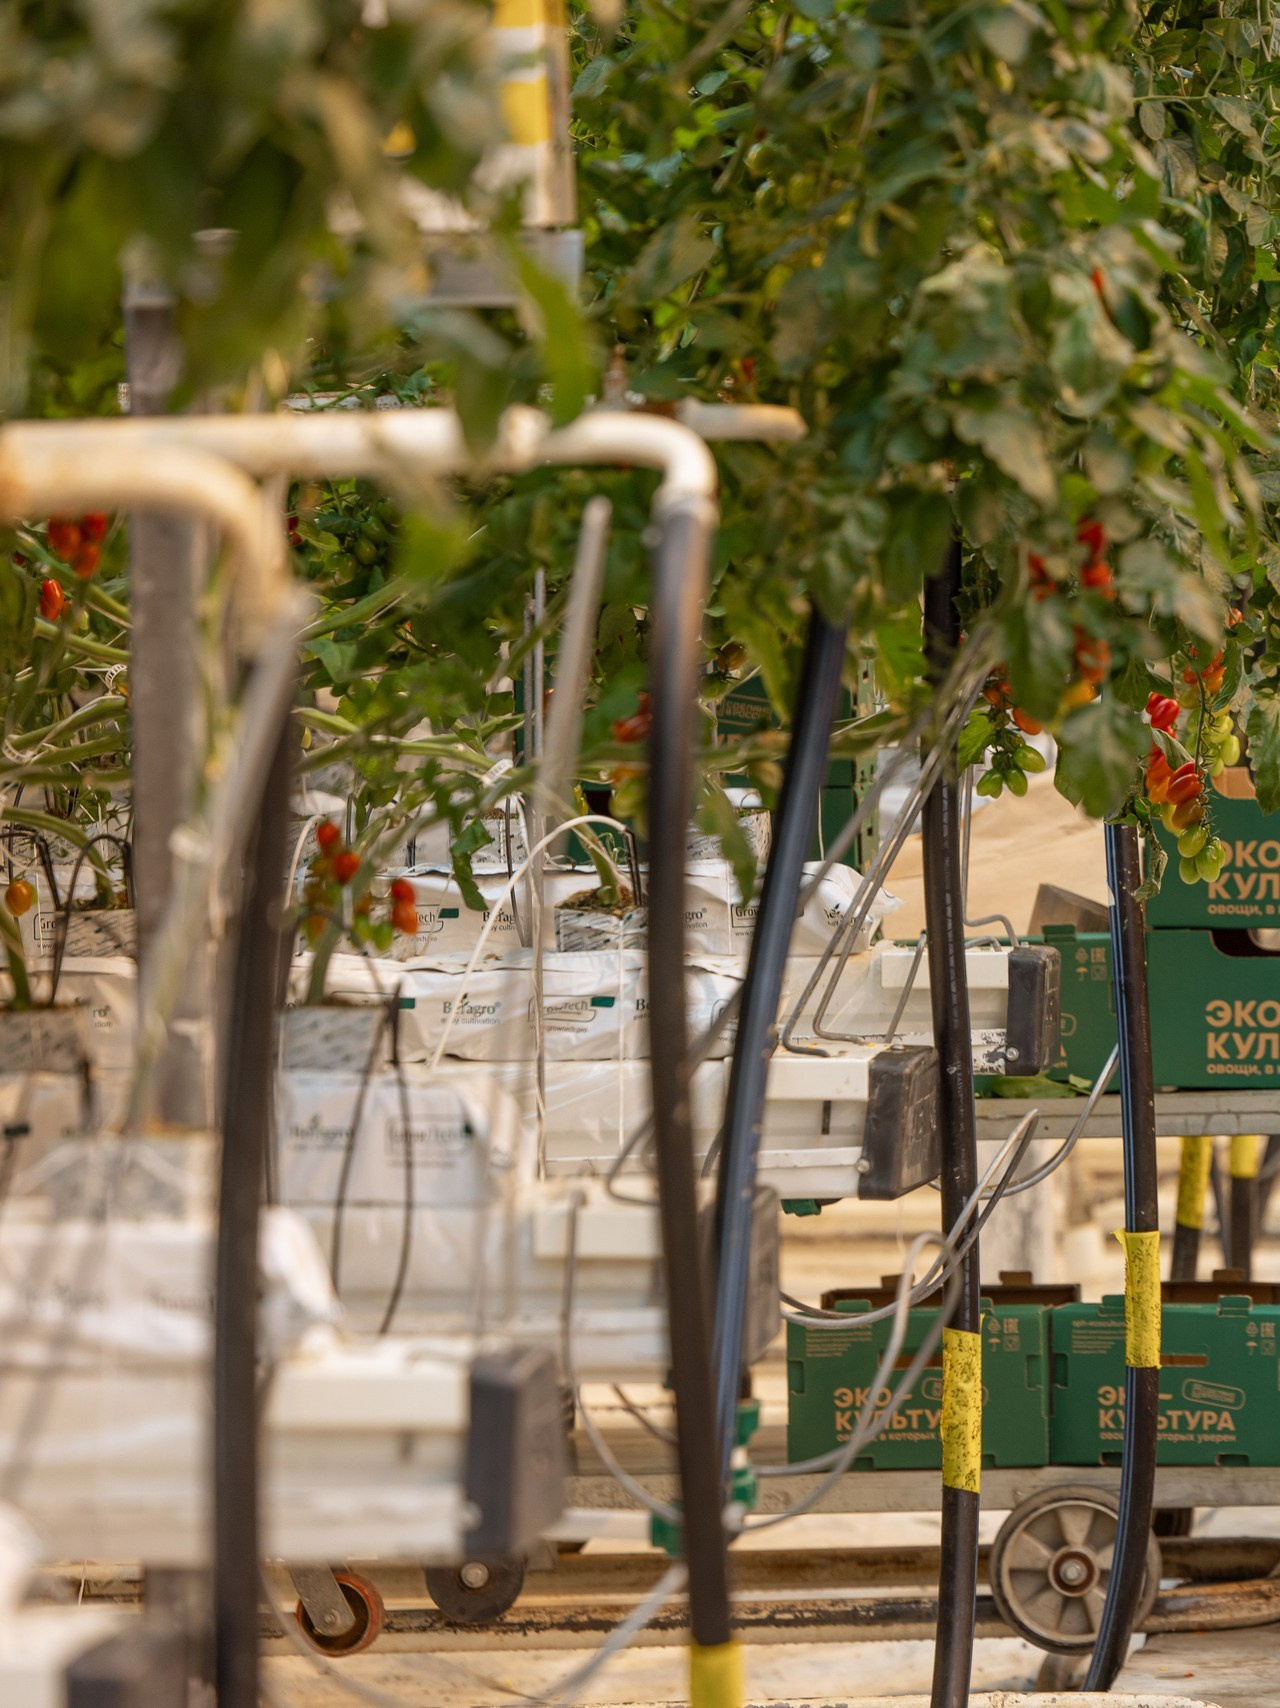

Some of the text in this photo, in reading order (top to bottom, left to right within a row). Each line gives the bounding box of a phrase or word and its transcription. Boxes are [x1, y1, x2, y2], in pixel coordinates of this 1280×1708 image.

[1207, 904, 1262, 916] овощи,
[1265, 905, 1275, 915] в
[1207, 1063, 1262, 1076] овощи,
[1265, 1064, 1273, 1075] в
